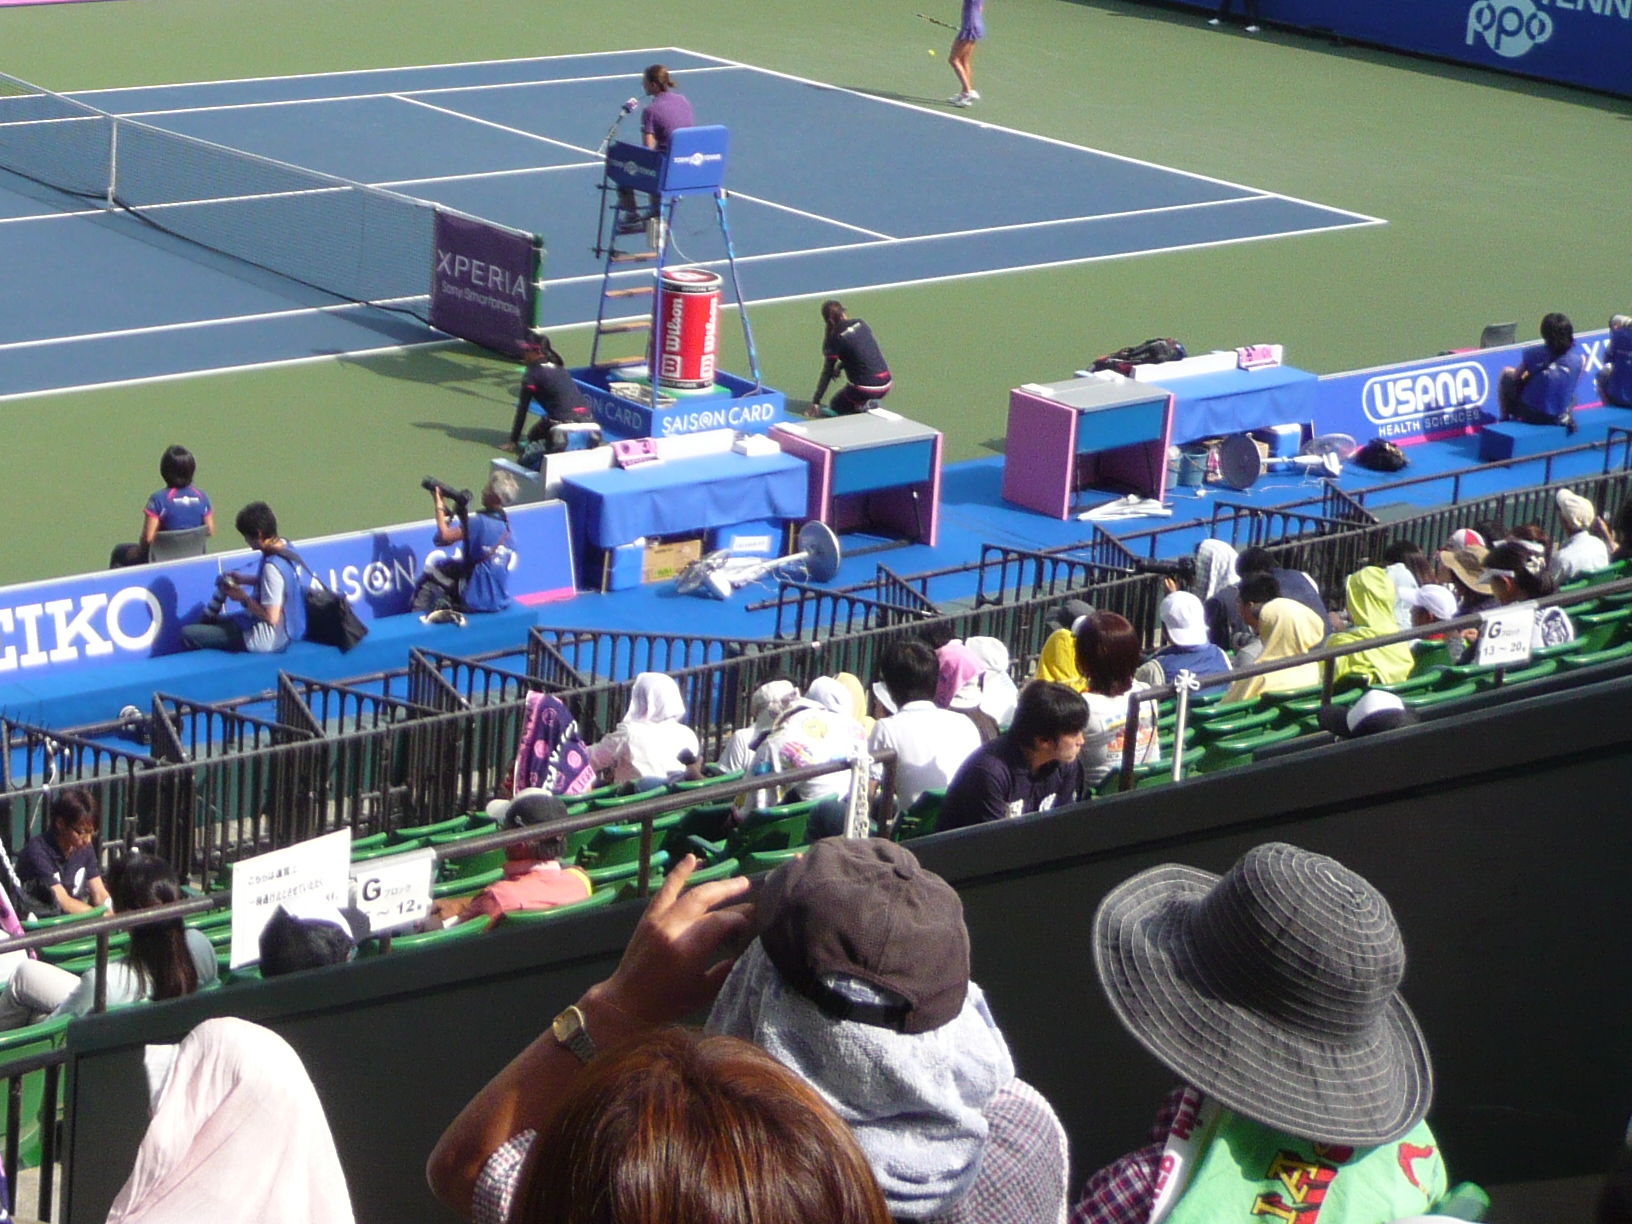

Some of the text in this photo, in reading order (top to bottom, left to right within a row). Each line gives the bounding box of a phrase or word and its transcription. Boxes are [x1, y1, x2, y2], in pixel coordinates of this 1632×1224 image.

[436, 249, 528, 301] XPERIA
[441, 280, 464, 298] Sony
[666, 298, 684, 352] Wilson
[703, 297, 718, 353] Wilson
[1372, 368, 1480, 417] USANA
[605, 402, 643, 429] CARD
[661, 402, 774, 433] SAISON CARD
[1378, 410, 1481, 437] HEALTH SCIENCES
[1488, 621, 1503, 639] G
[361, 877, 382, 902] G
